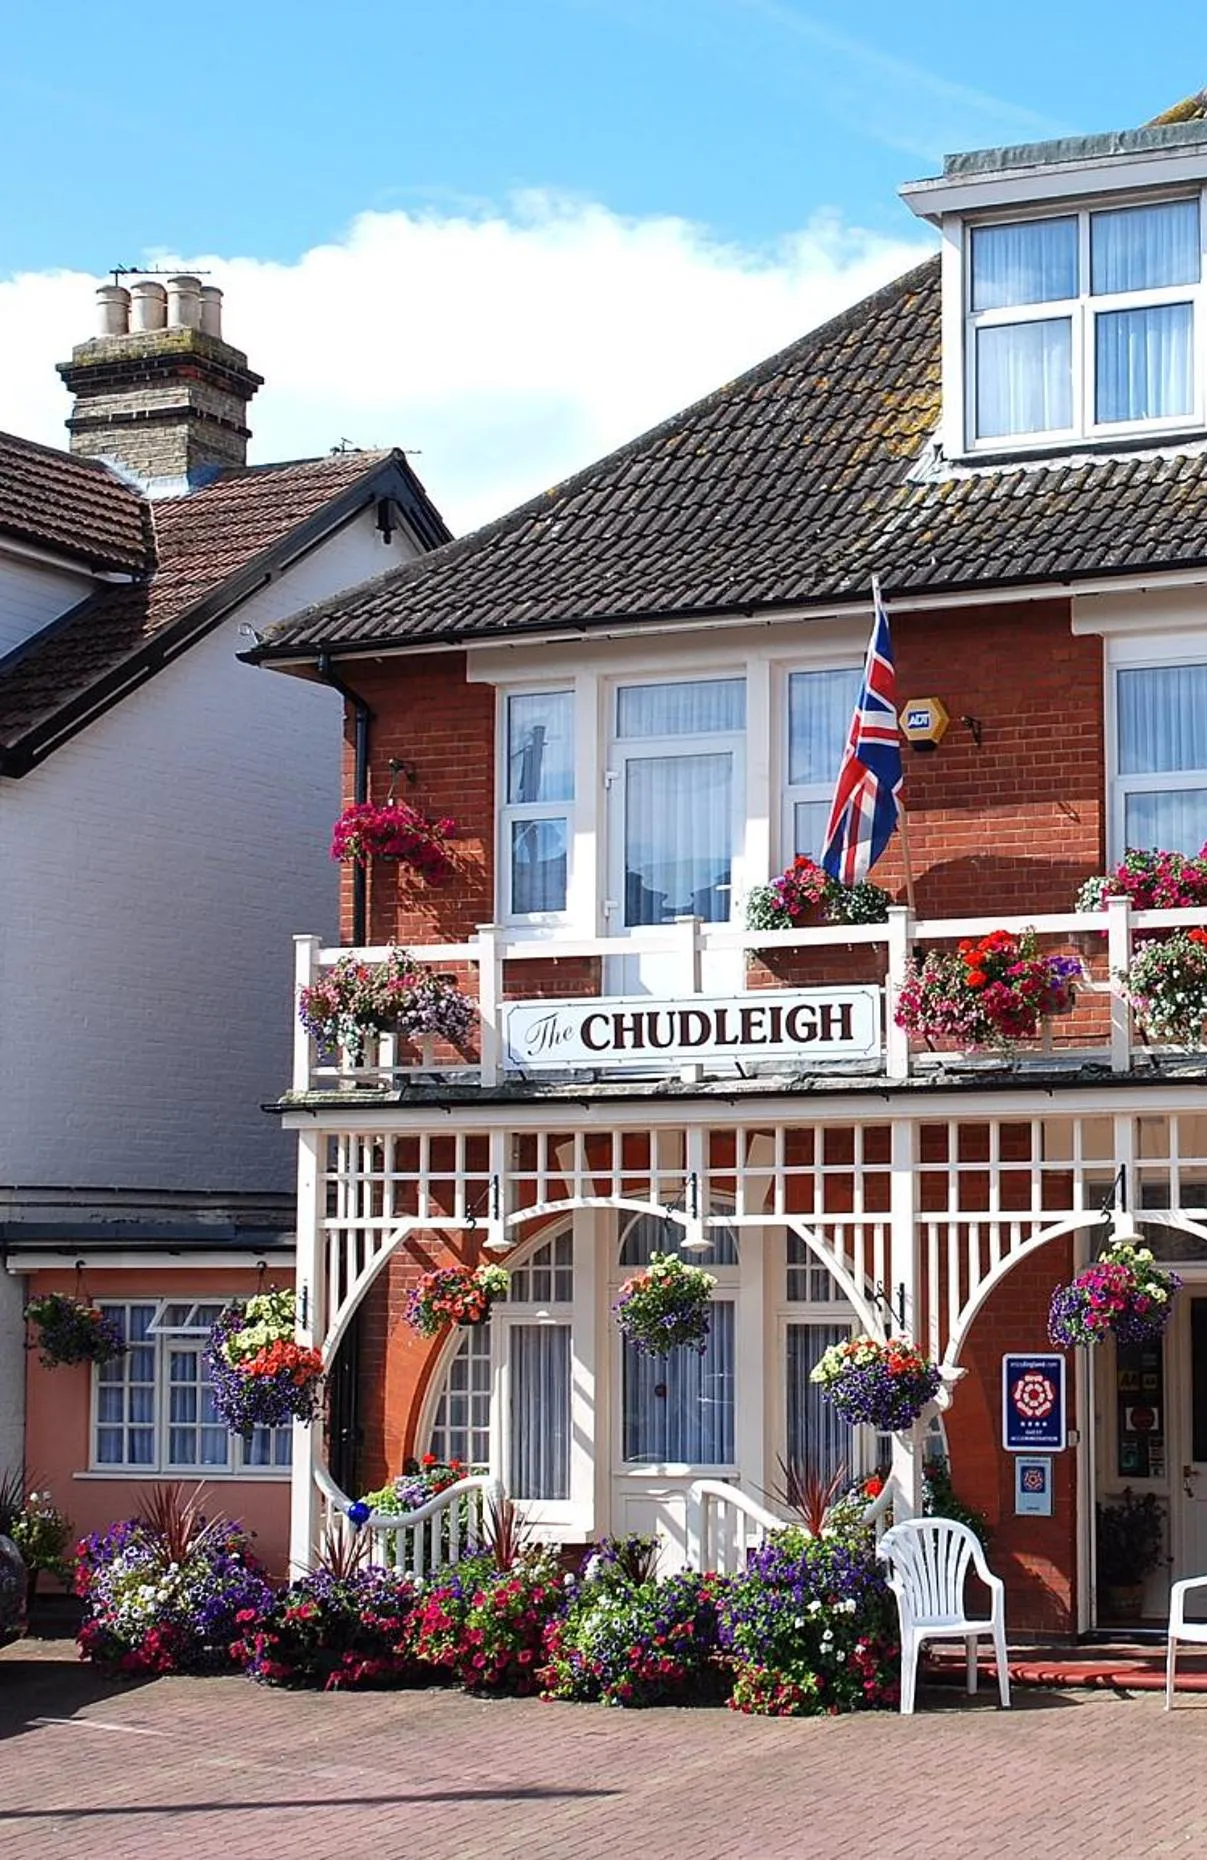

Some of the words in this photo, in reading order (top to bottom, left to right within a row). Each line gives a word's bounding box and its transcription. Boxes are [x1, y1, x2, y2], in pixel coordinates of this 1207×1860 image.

[908, 712, 930, 728] ADT
[525, 1012, 574, 1056] The
[580, 1003, 854, 1052] CHUDLEIGH
